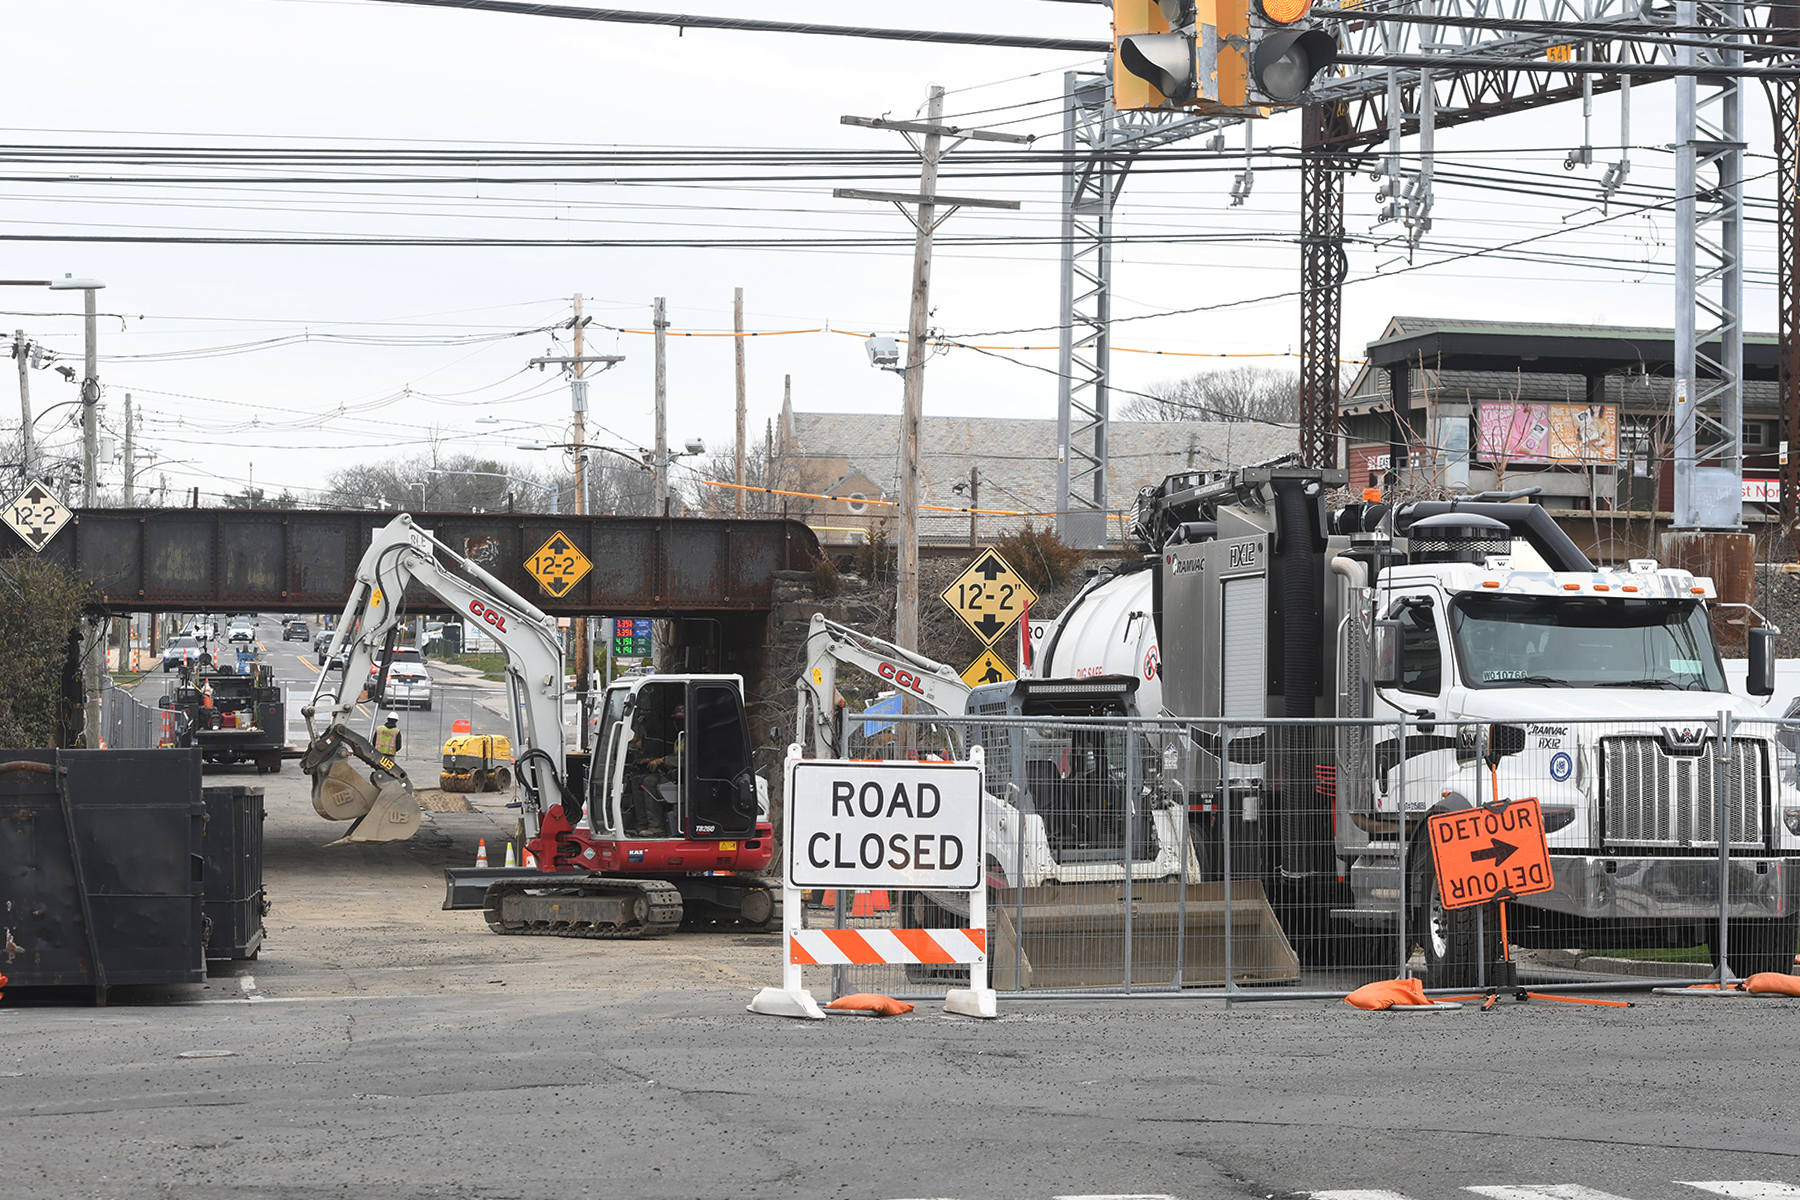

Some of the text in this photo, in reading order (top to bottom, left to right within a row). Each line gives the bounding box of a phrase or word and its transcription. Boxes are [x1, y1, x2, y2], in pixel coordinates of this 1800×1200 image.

[535, 555, 582, 575] 12'-2"
[469, 599, 507, 634] CCL
[878, 662, 924, 695] CCL
[831, 781, 941, 819] ROAD
[1439, 808, 1532, 843] DETOUR
[807, 832, 964, 870] CLOSED
[1450, 863, 1543, 899] DETOUR
